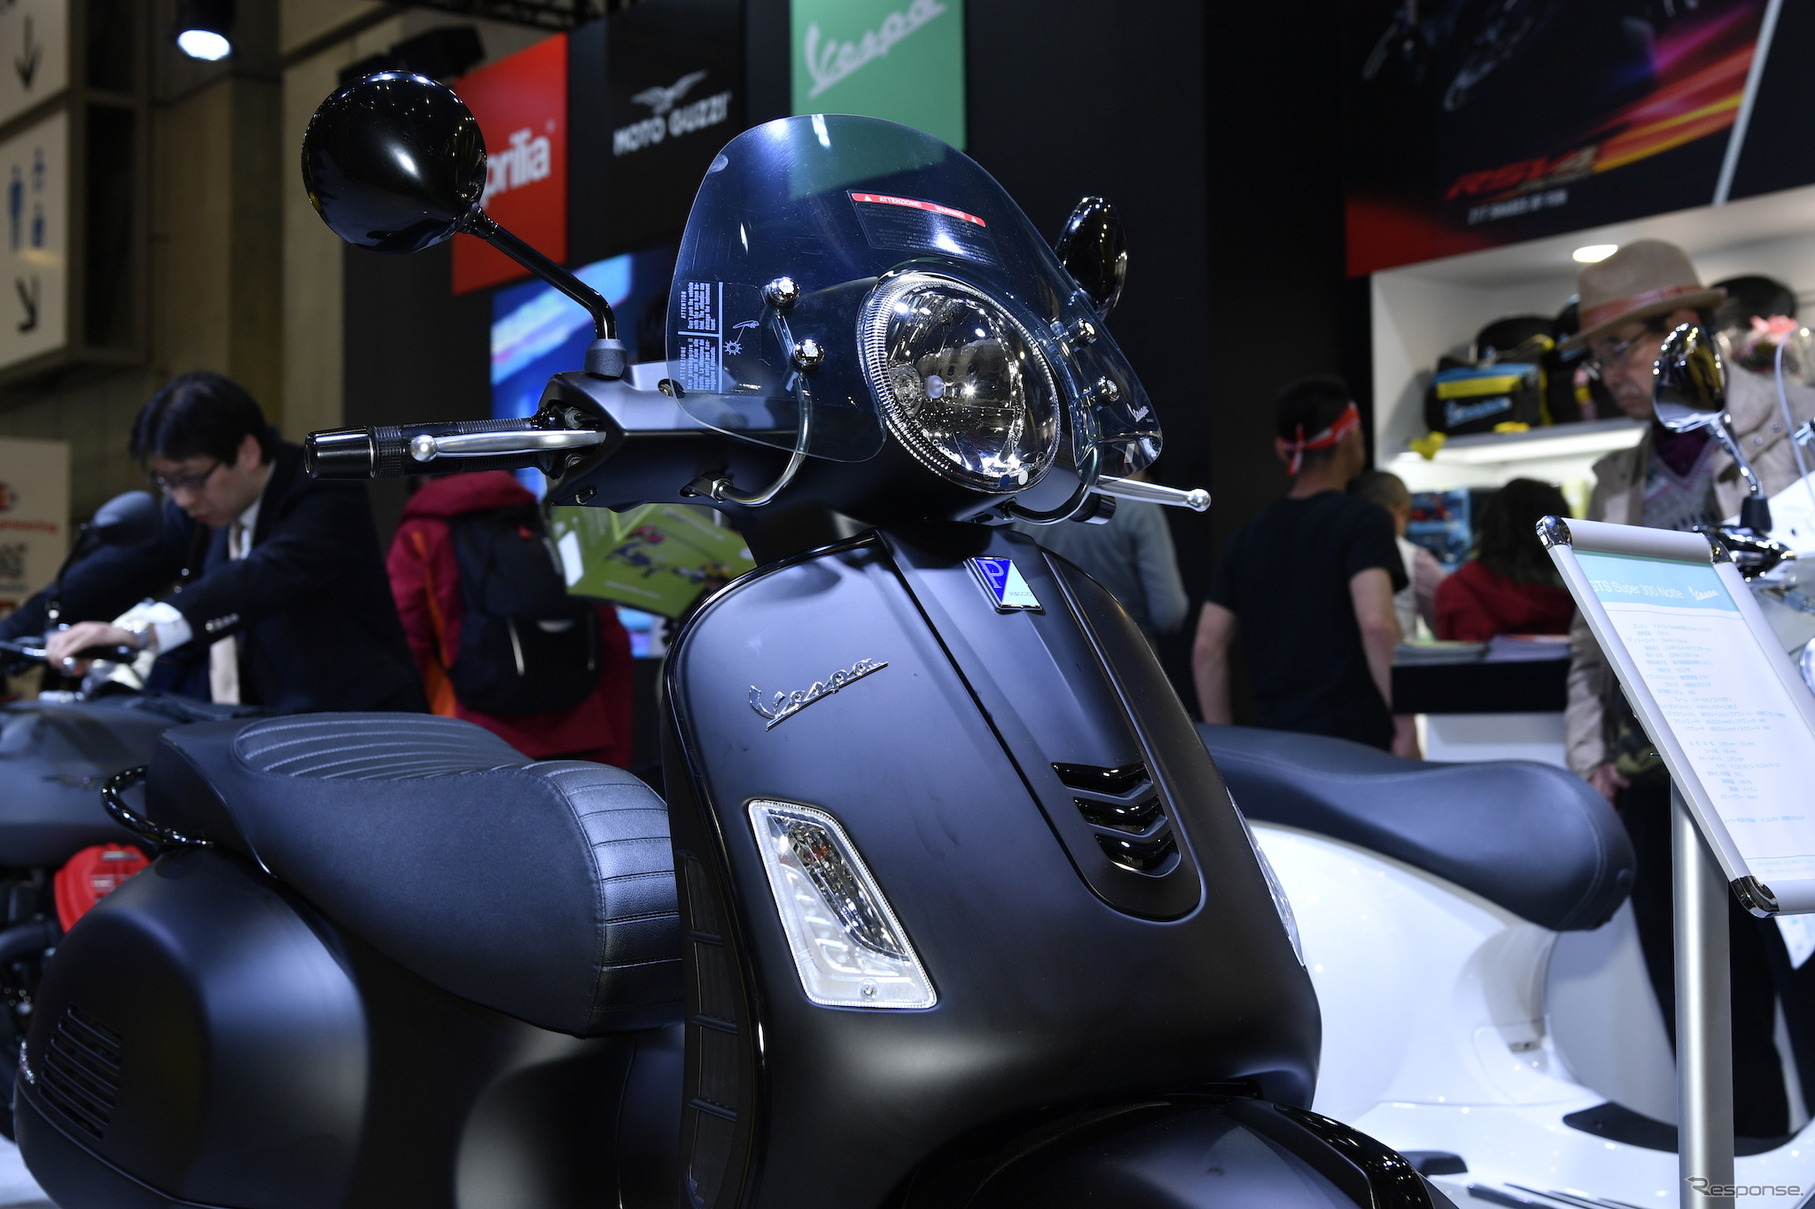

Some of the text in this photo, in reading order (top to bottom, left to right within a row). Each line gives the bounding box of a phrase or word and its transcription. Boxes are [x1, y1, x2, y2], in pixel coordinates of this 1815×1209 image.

[804, 0, 947, 98] Vespa
[613, 93, 728, 156] MOTO GUZZI
[480, 127, 551, 210] prilia
[1611, 581, 1639, 596] Super
[749, 657, 888, 733] Vespa
